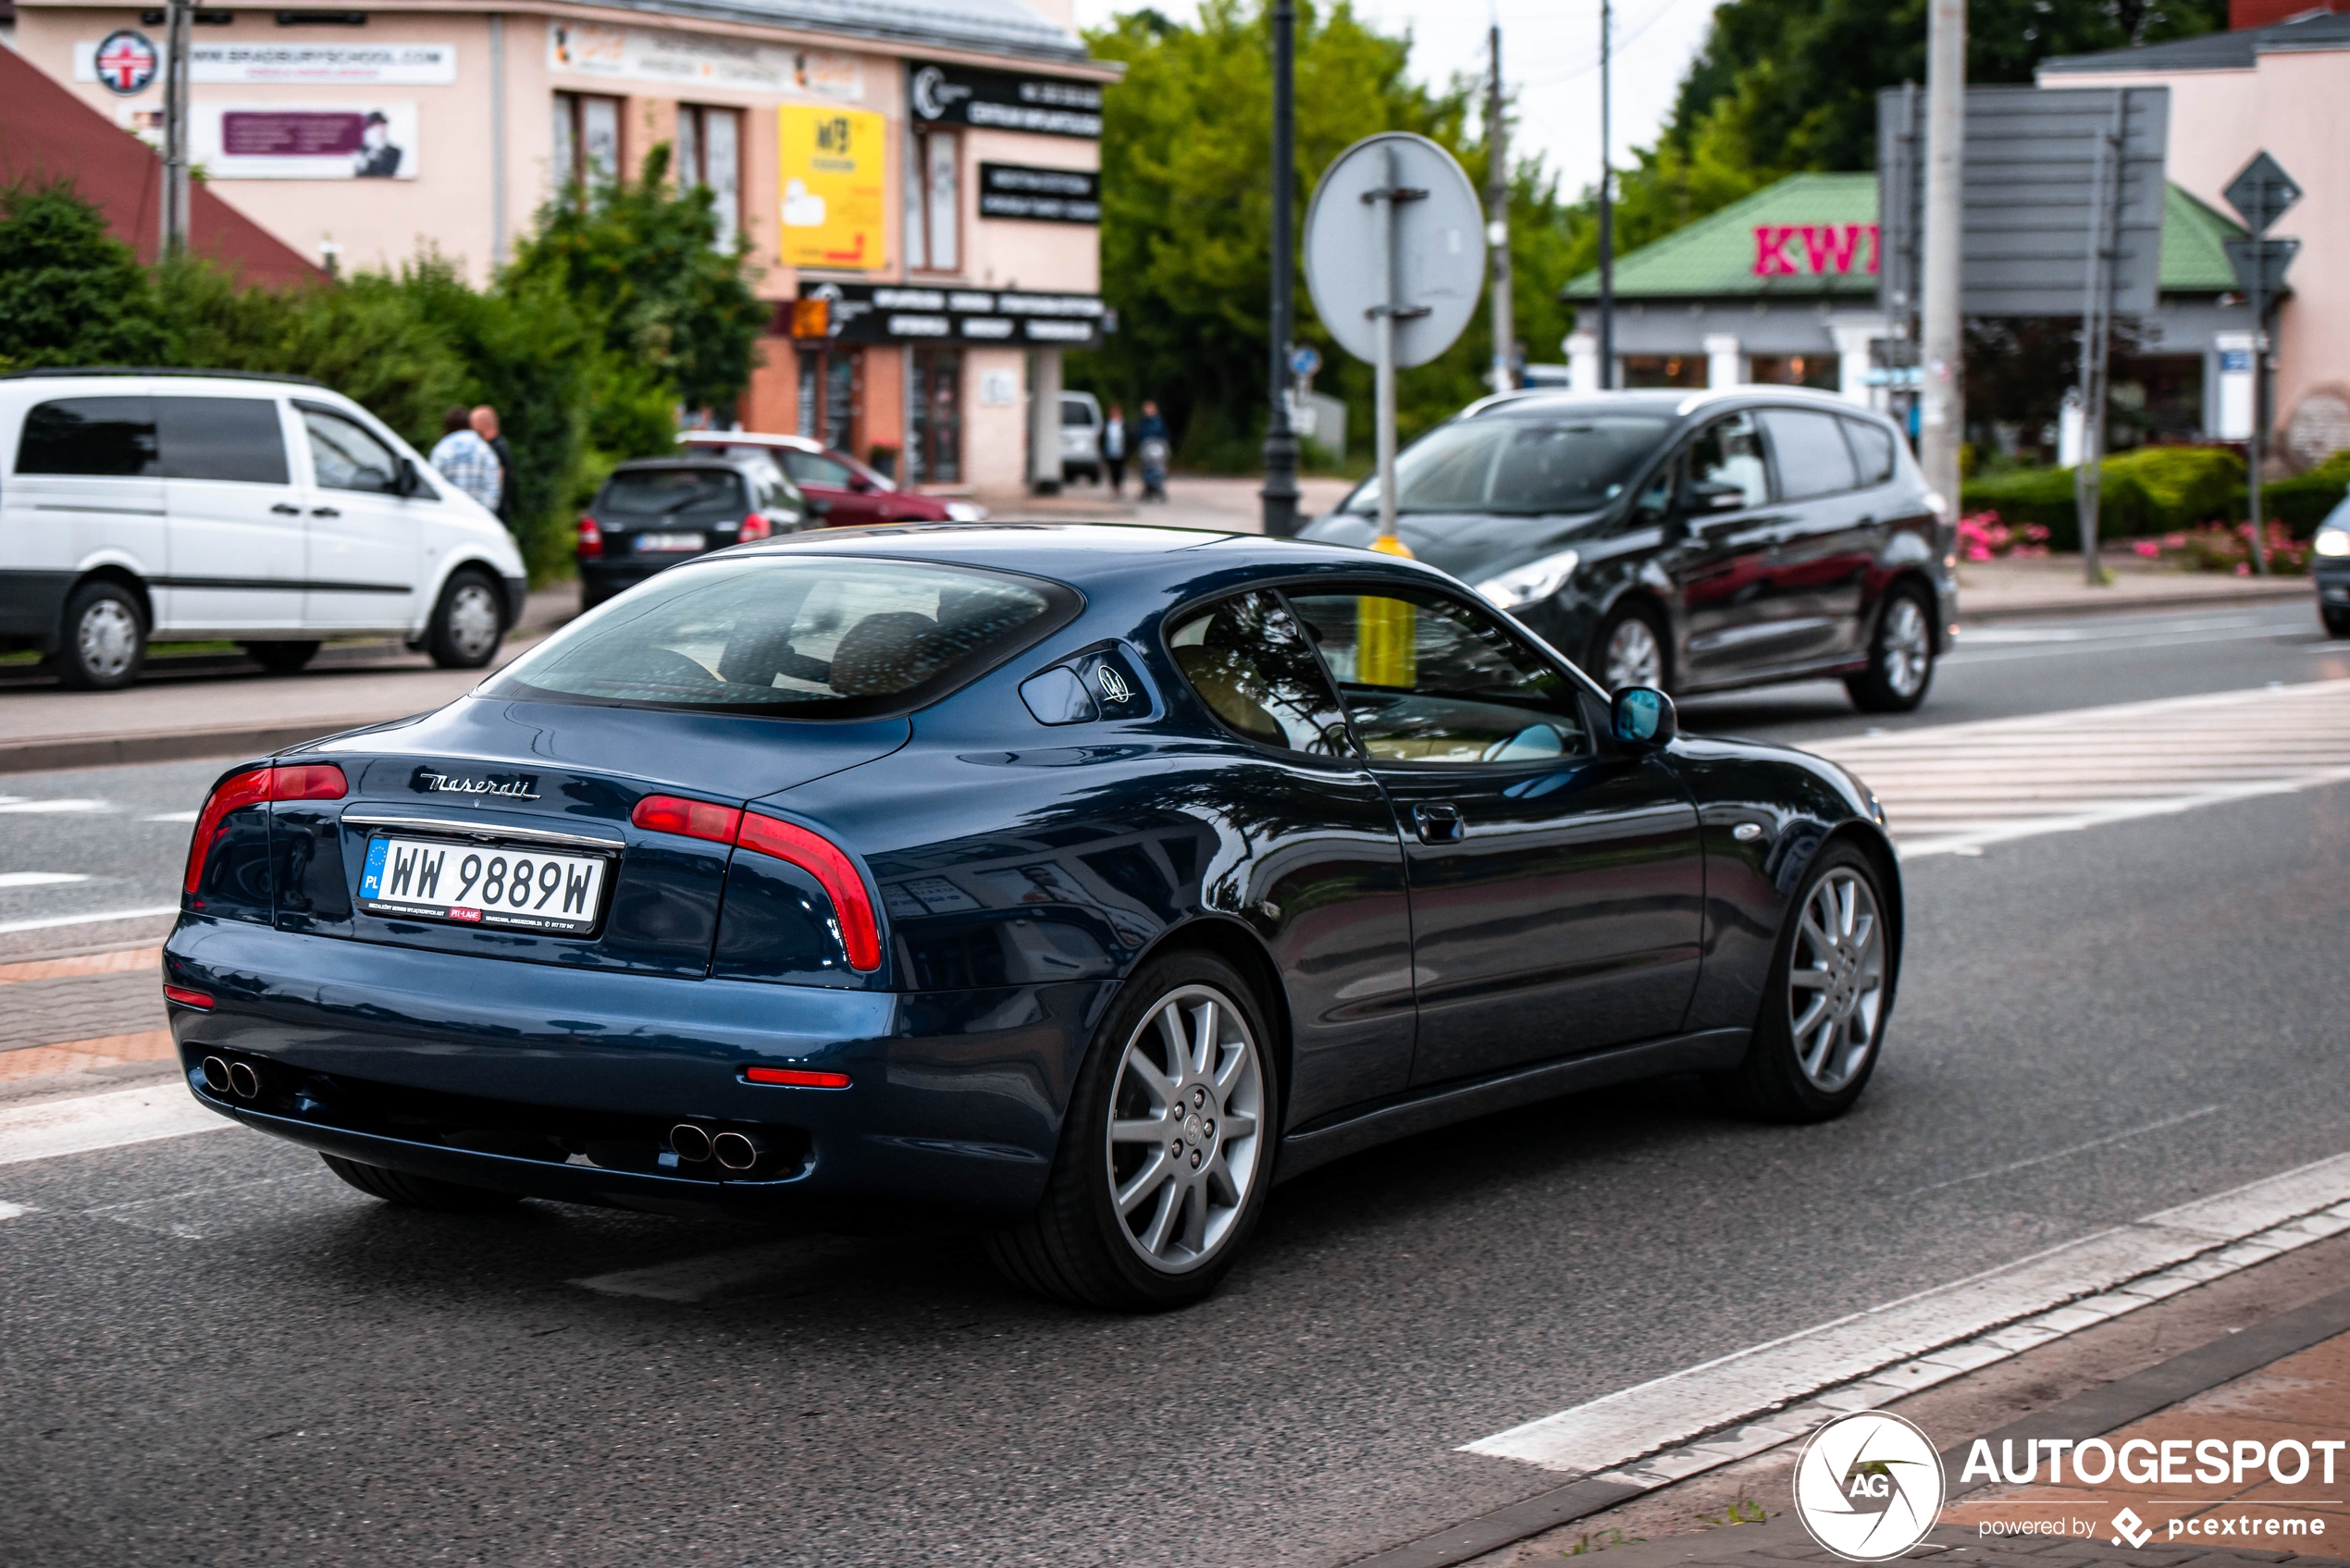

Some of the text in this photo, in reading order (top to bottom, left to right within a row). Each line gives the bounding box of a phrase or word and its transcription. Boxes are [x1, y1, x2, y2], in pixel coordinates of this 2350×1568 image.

[420, 773, 541, 798] Maserati
[365, 875, 378, 890] PL
[390, 846, 593, 915] WW 9889W
